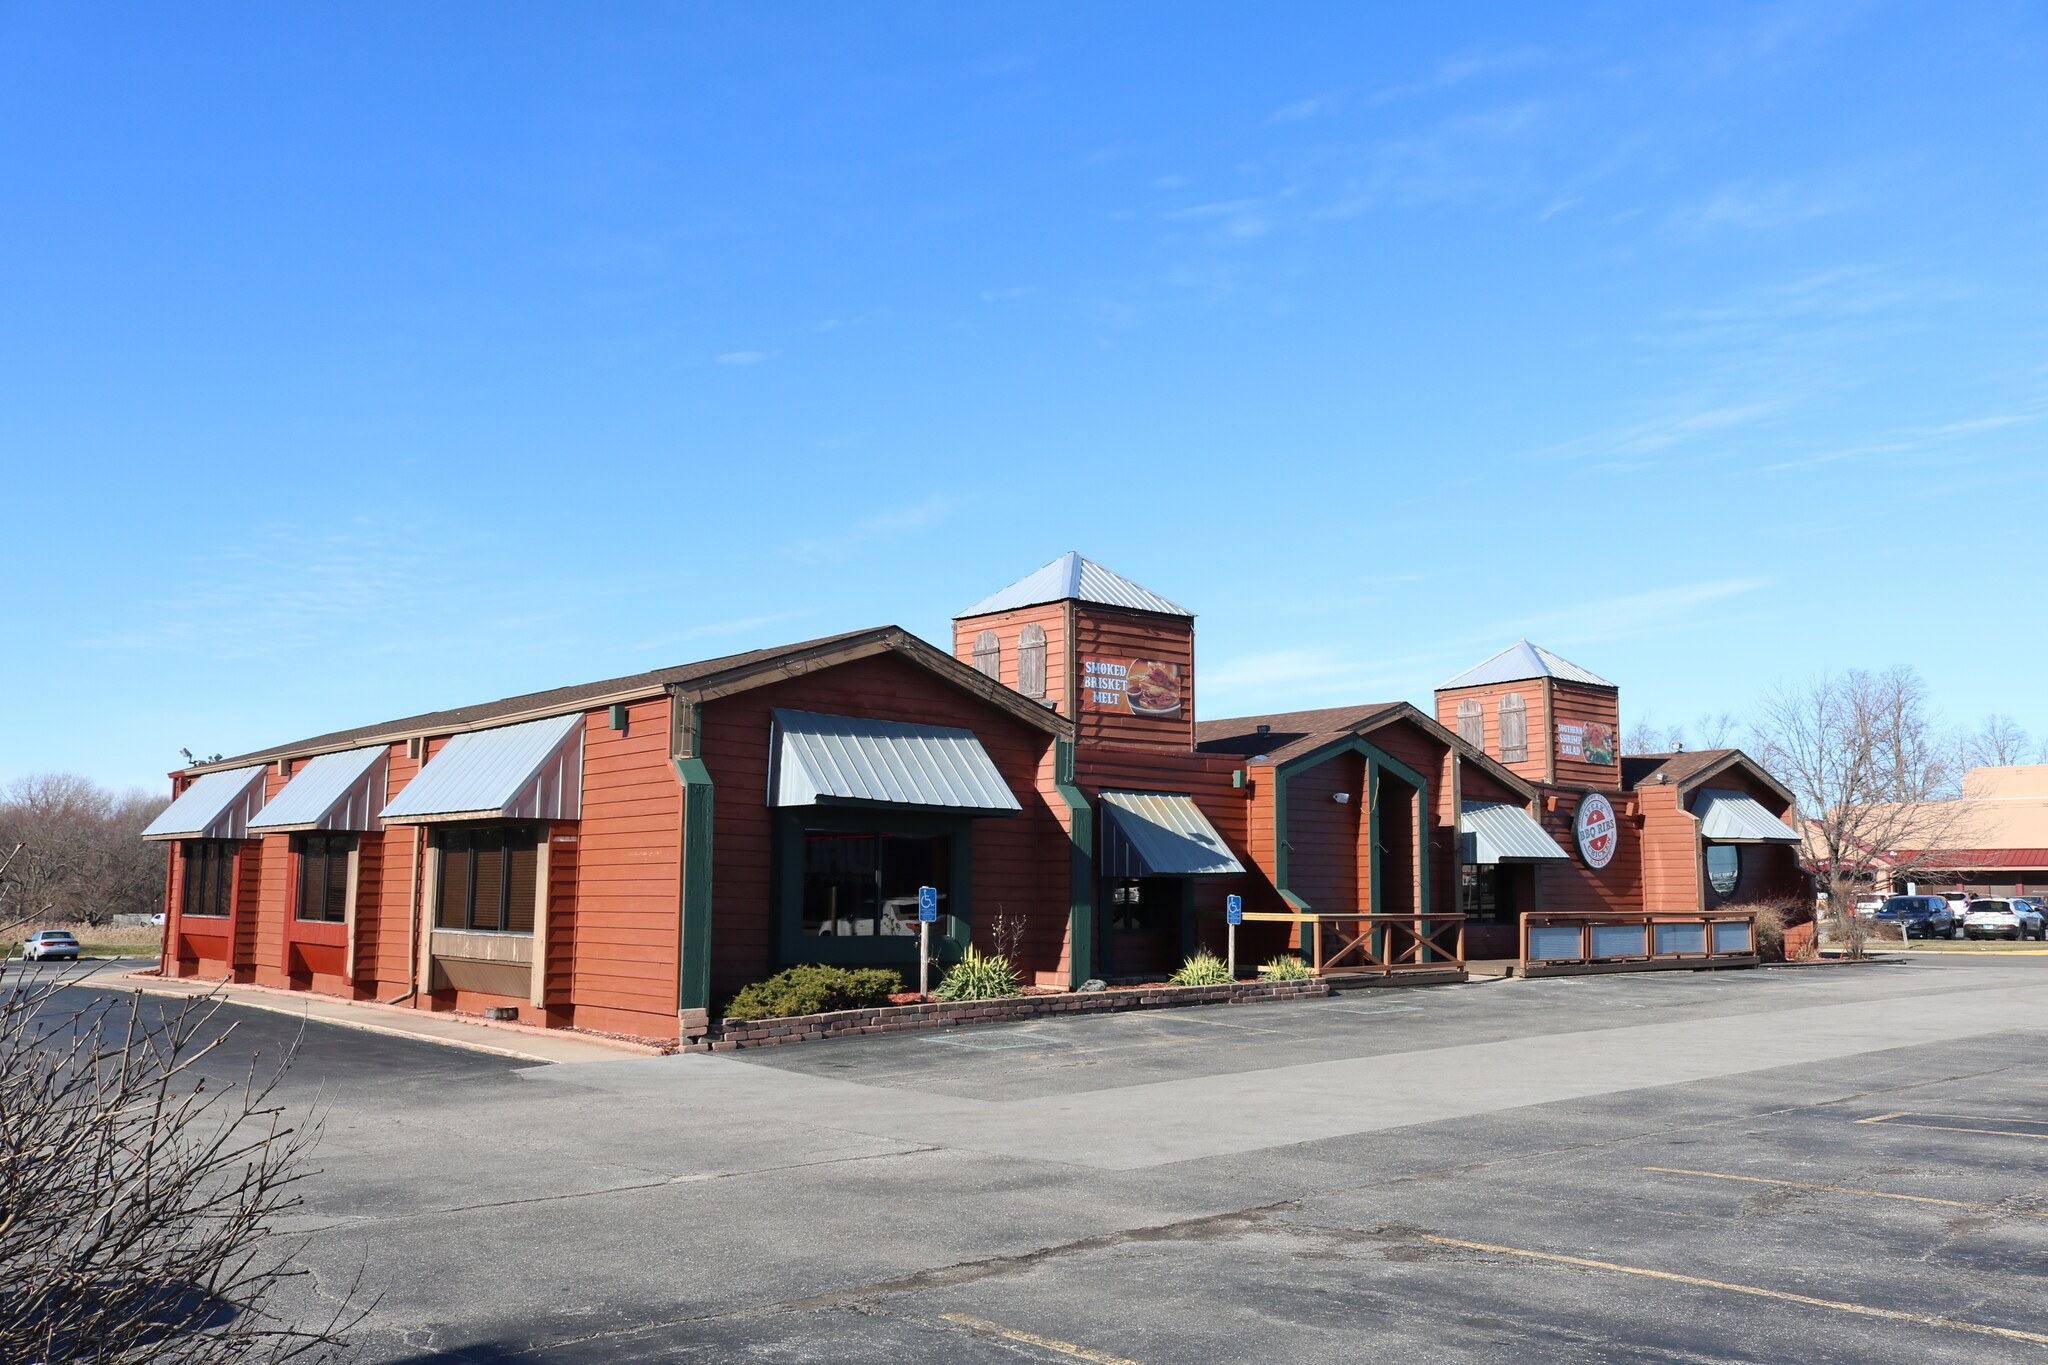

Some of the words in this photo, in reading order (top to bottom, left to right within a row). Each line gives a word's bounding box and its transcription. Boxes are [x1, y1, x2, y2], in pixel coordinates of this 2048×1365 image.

[1085, 661, 1127, 677] SMOKED
[1084, 676, 1128, 691] BRISKET
[1093, 691, 1120, 705] MELT
[1558, 724, 1583, 735] SOUTHERN
[1559, 733, 1583, 745] SHRIMP
[1561, 744, 1581, 756] SALAD
[1585, 803, 1605, 818] STEAK
[1579, 826, 1596, 842] BBQ
[1597, 819, 1615, 835] RIBS
[1587, 837, 1611, 858] CHICKEN
